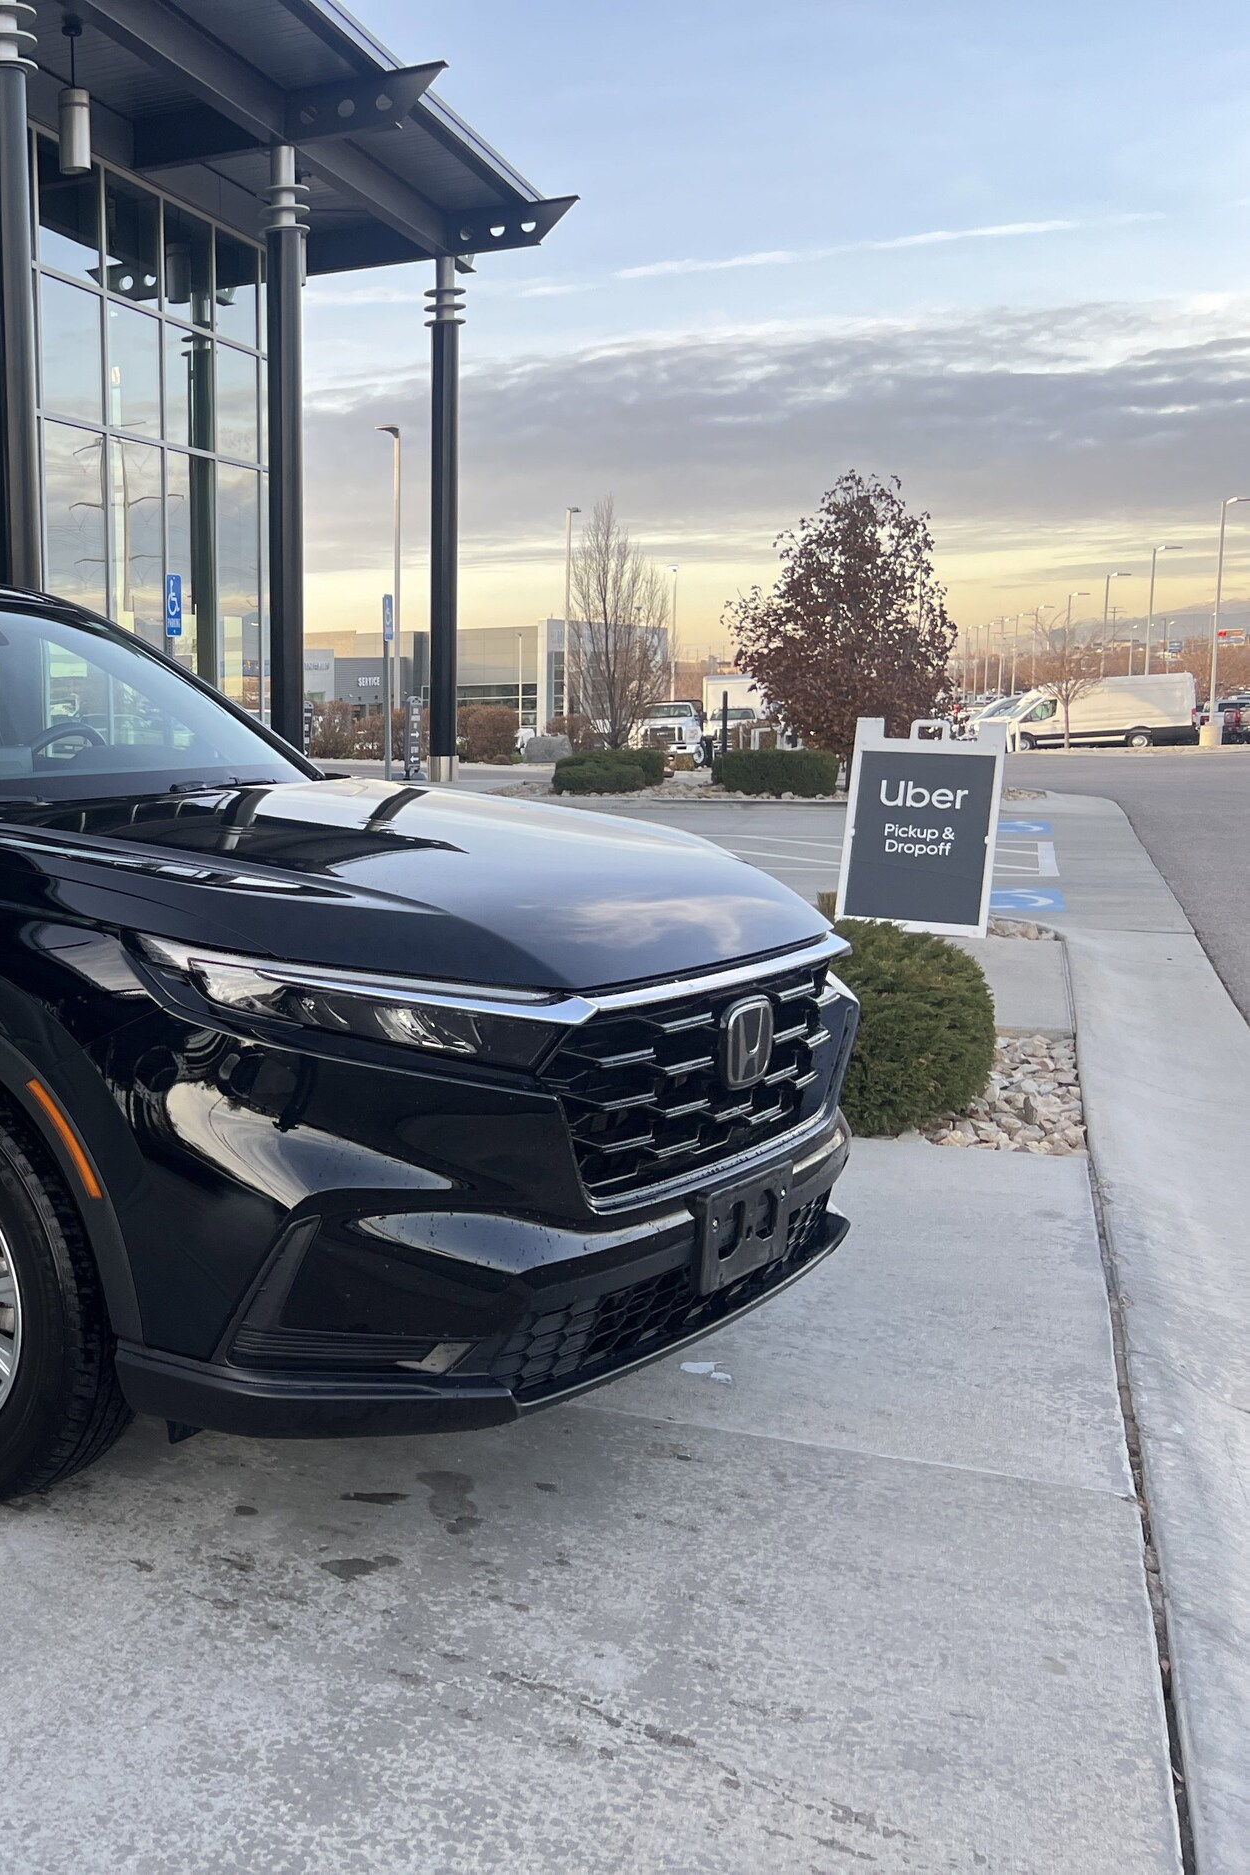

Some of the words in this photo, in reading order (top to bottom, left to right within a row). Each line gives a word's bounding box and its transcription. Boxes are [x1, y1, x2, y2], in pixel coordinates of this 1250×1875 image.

[357, 676, 381, 687] SERVICE
[879, 779, 969, 809] Uber
[884, 823, 939, 842] Pickup
[942, 826, 955, 840] &
[884, 839, 952, 857] Dropoff
